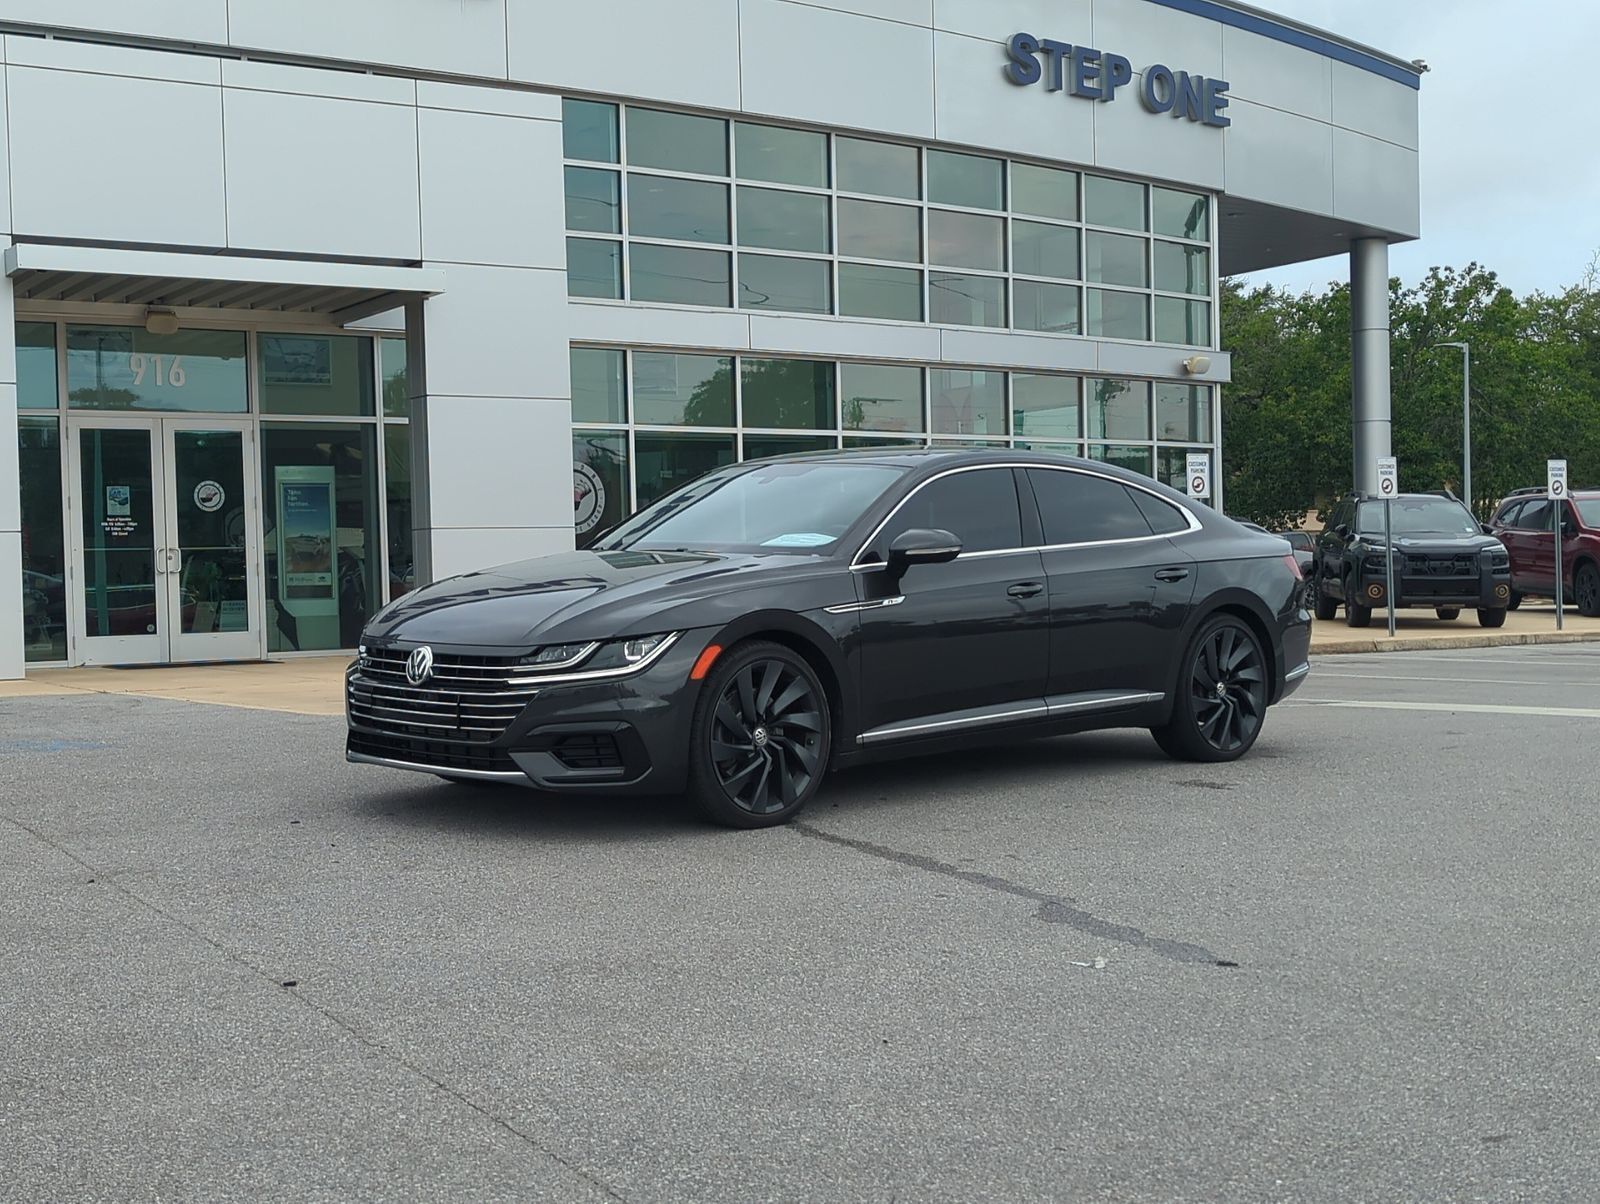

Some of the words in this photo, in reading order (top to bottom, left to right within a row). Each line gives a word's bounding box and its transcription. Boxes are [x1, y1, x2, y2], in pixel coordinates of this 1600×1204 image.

[1004, 32, 1132, 102] STEP
[1140, 63, 1231, 128] ONE
[129, 352, 186, 388] 916
